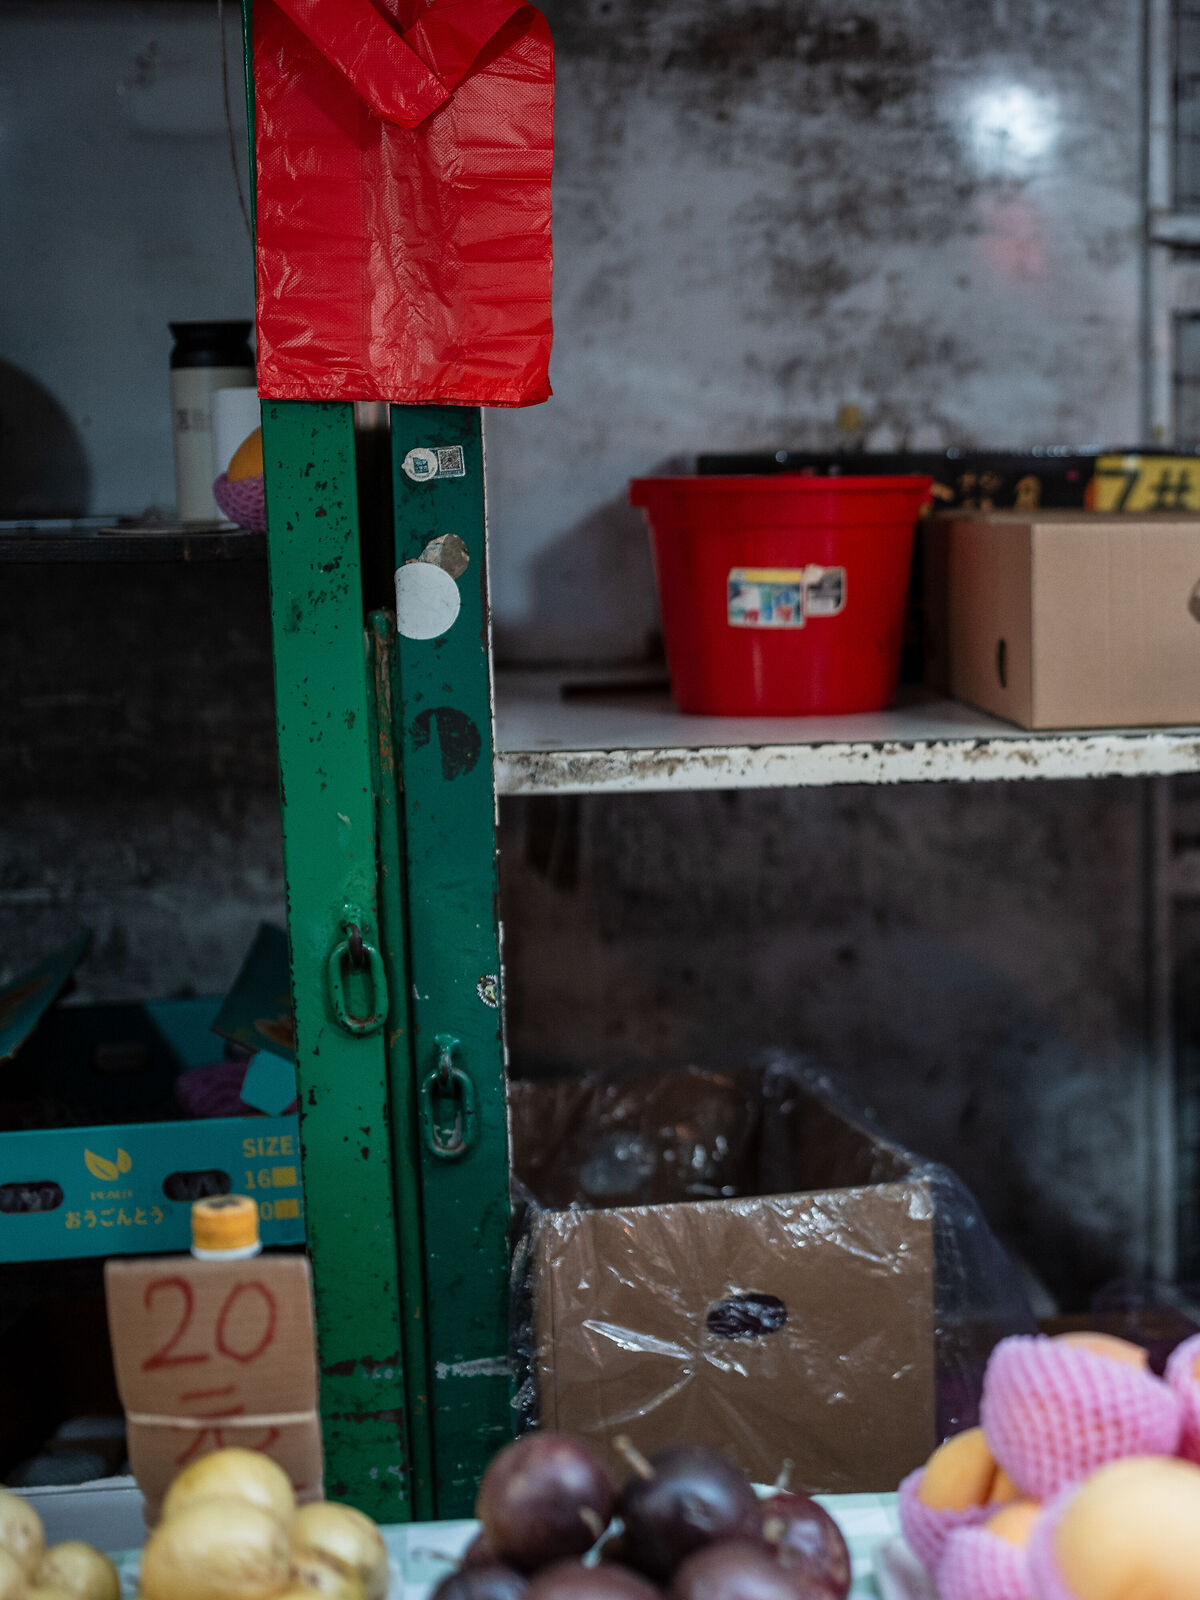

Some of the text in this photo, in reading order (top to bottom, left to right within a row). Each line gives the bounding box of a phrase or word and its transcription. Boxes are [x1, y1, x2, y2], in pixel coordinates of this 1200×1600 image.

[244, 1168, 272, 1189] 16
[65, 1206, 164, 1229] おうごんとう
[142, 1276, 278, 1373] 20
